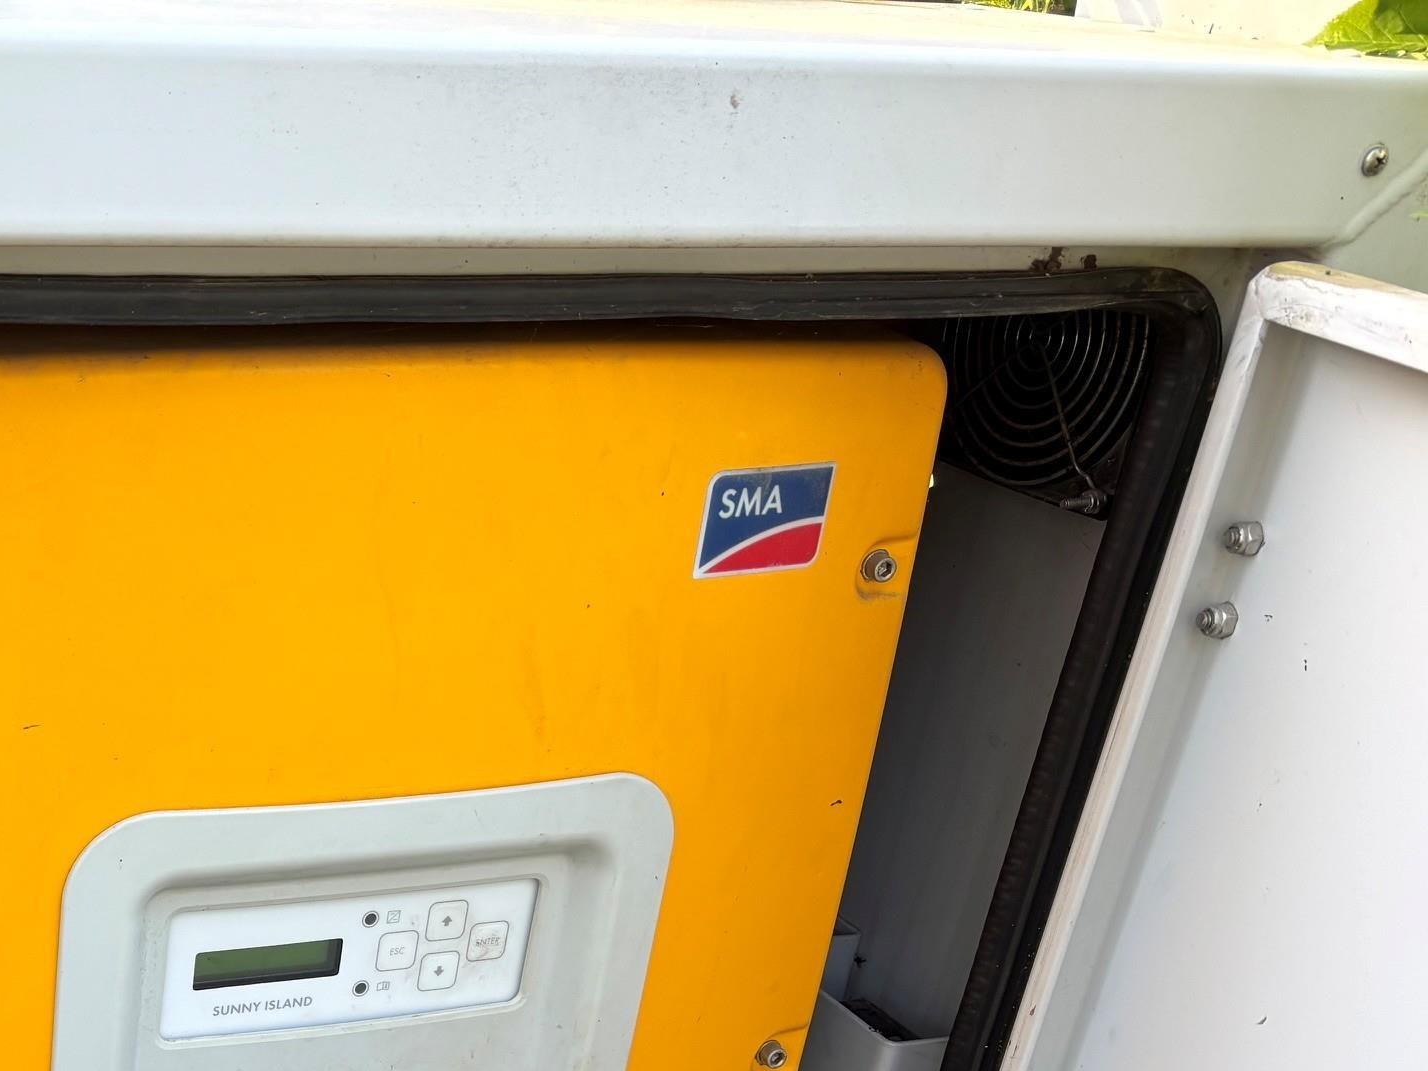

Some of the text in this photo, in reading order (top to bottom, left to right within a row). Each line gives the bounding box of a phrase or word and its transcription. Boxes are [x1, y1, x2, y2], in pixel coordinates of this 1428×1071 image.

[718, 484, 783, 519] SMA
[475, 936, 501, 947] ENTER
[389, 946, 406, 956] ESC
[212, 996, 313, 1017] SUNNY ISLAND
